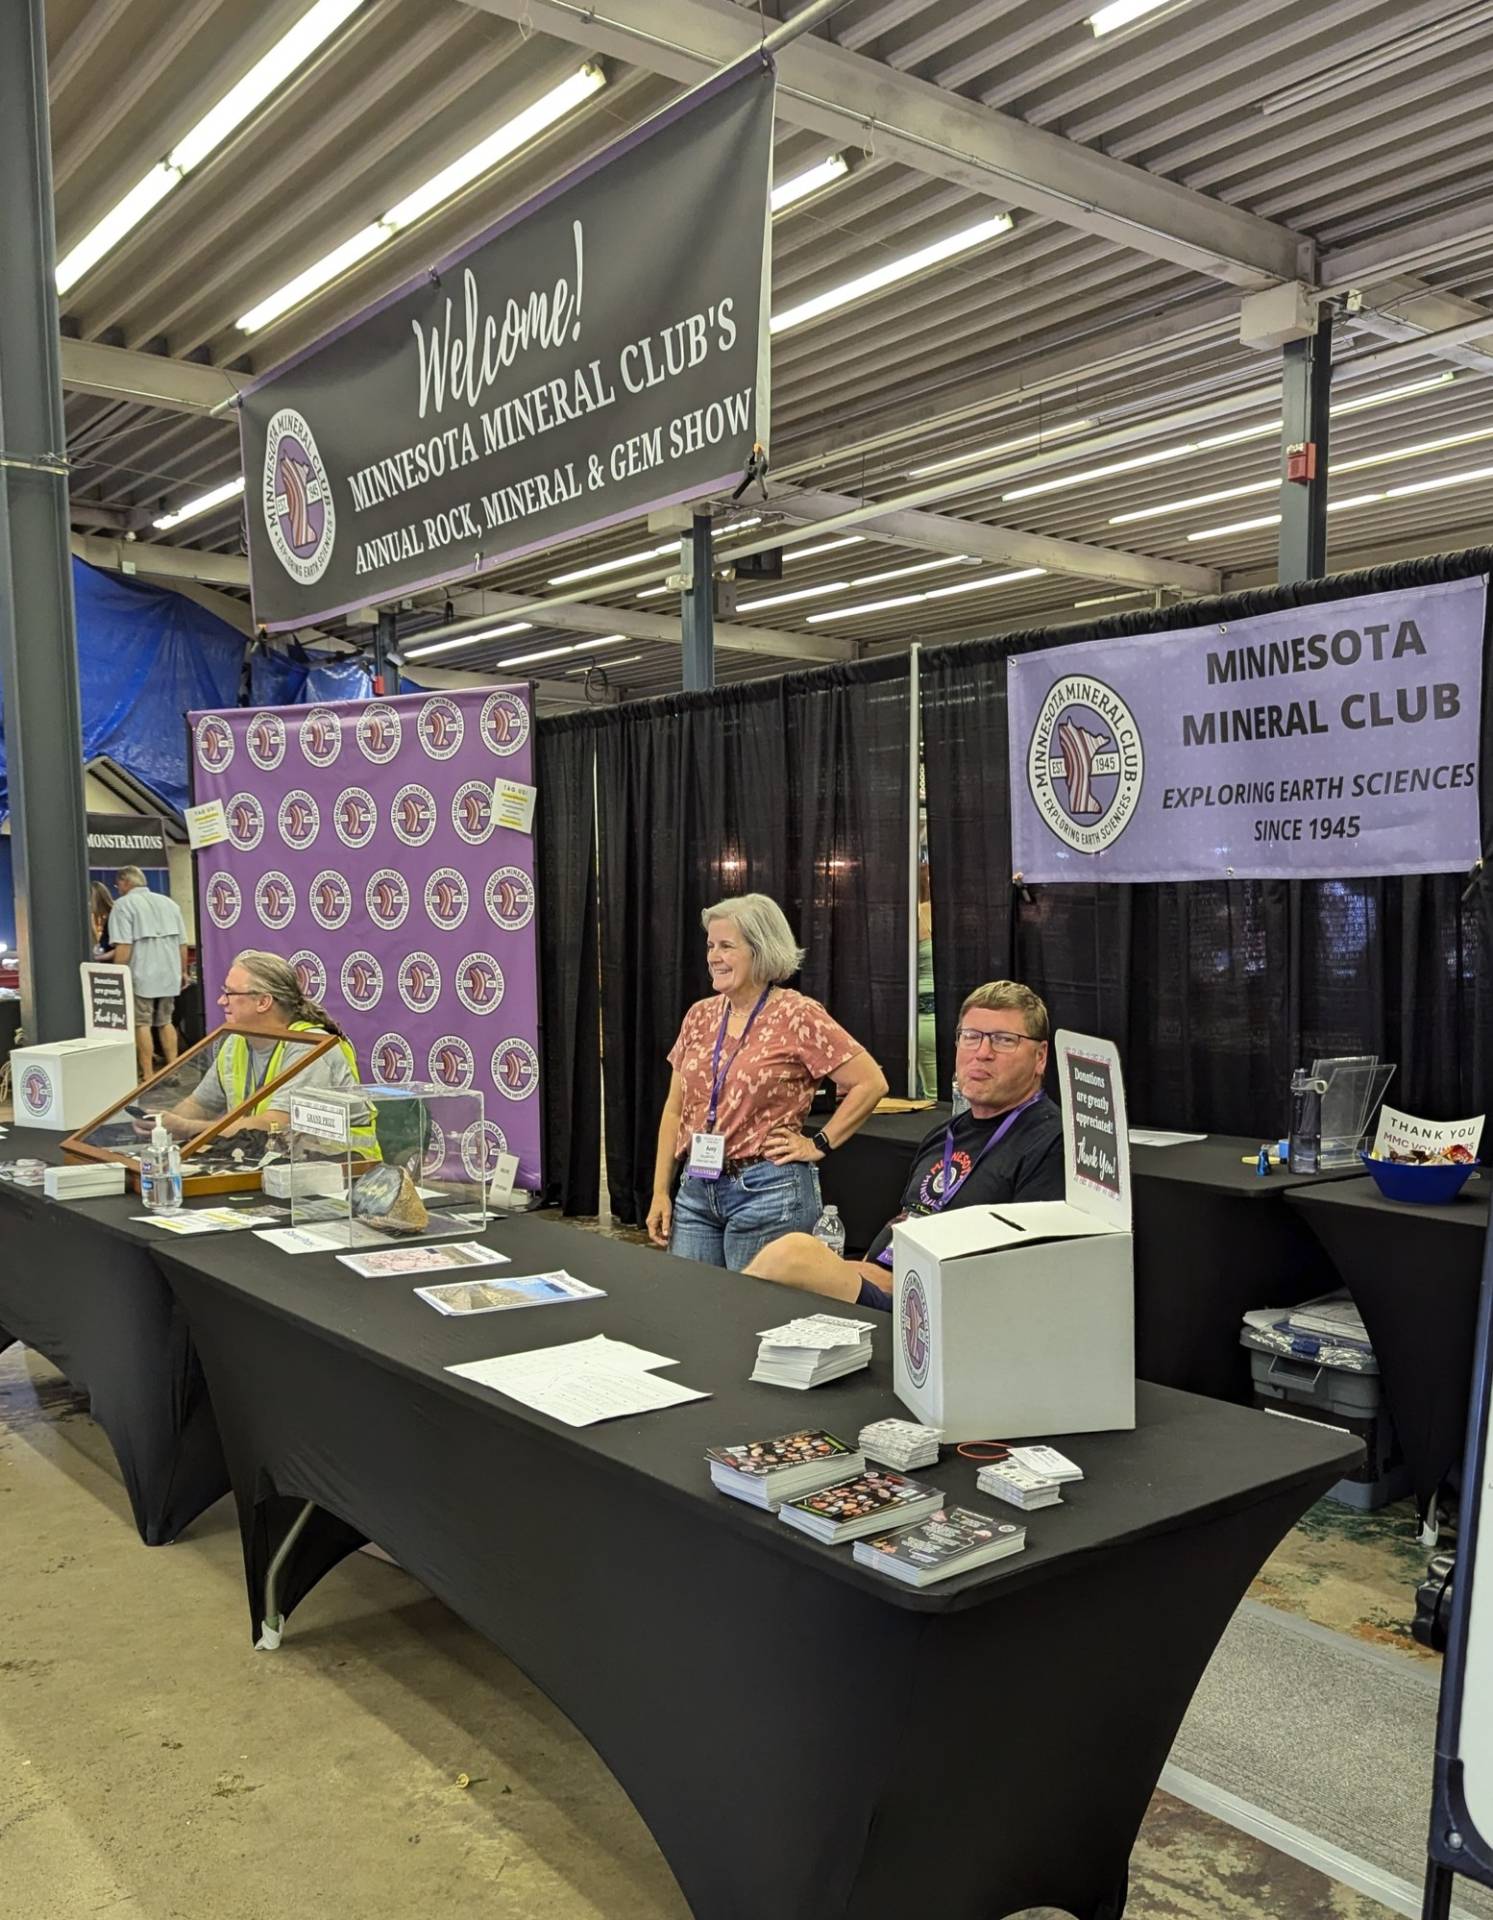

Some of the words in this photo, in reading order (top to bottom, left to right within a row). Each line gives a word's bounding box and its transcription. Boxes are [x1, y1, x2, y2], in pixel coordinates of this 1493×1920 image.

[412, 220, 583, 418] Welcome!
[348, 422, 477, 512] MINNESOTA
[480, 360, 615, 456] MINERAL
[620, 298, 737, 394] CLUB'S
[265, 424, 279, 528] MINNESOTA
[277, 414, 314, 456] MINERAL
[312, 455, 331, 506] CLUB
[355, 523, 424, 575] ANNUAL
[428, 503, 483, 551] ROCK,
[481, 467, 582, 528] MINERAL
[587, 456, 605, 490] &
[610, 426, 664, 481] GEM
[669, 388, 753, 458] SHOW
[1206, 619, 1427, 686] MINNESOTA
[1035, 689, 1066, 788] MINNESOTA
[1065, 683, 1125, 730] MINERAL
[1119, 729, 1138, 782] CLUB
[1182, 700, 1329, 747] MINERAL
[1340, 682, 1461, 730] CLUB
[1052, 761, 1065, 774] EST.
[1095, 757, 1115, 772] 1945
[1162, 781, 1275, 810] EXPLORING
[1280, 775, 1343, 803] EARTH
[1351, 762, 1475, 798] SCIENCES
[1044, 798, 1080, 843] EXPLORING
[1081, 832, 1100, 846] EARTH
[1100, 794, 1131, 840] SCIENCES
[1254, 819, 1302, 841] SINCE
[1308, 815, 1361, 841] 1945
[1074, 1067, 1106, 1089] Donations
[1076, 1092, 1087, 1103] are
[1087, 1094, 1109, 1114] greatly
[1076, 1112, 1114, 1135] appreciated!
[1383, 1132, 1409, 1148] MMC
[1391, 1117, 1444, 1140] THANK
[1450, 1126, 1475, 1139] YOU
[1077, 1136, 1098, 1168] Thank
[1098, 1149, 1116, 1181] You!
